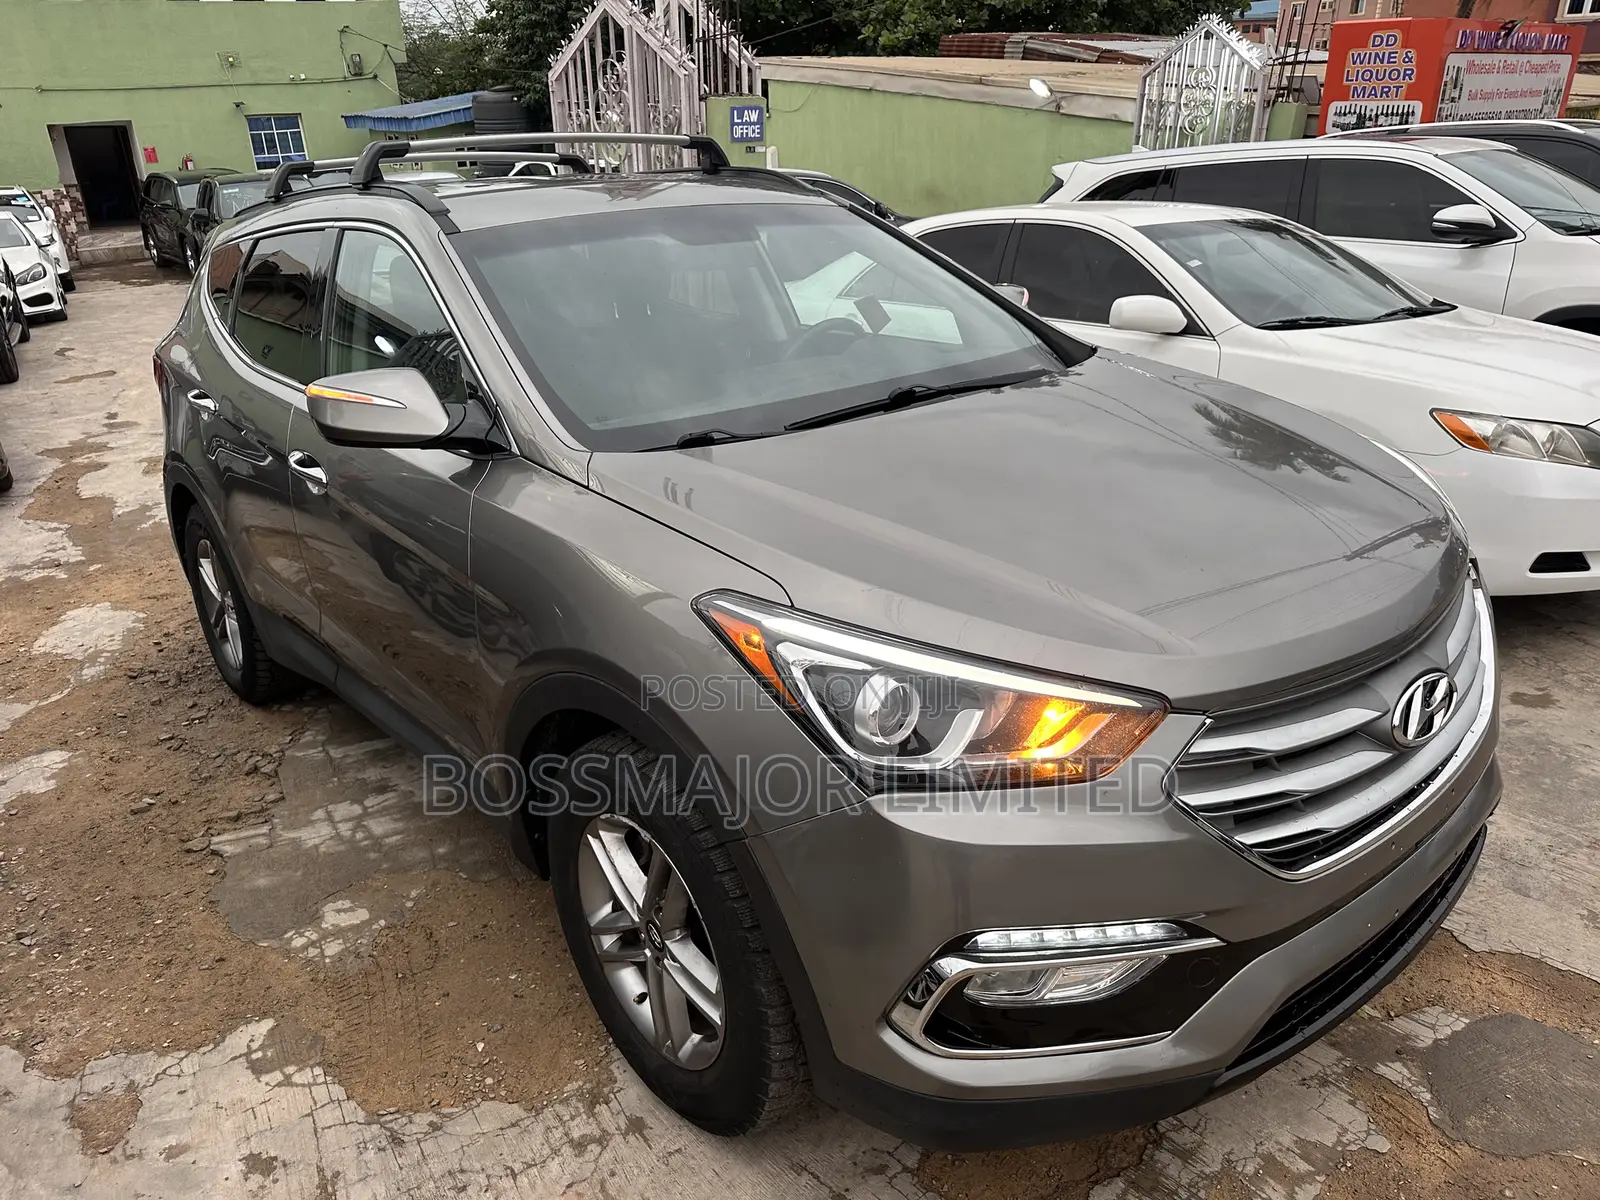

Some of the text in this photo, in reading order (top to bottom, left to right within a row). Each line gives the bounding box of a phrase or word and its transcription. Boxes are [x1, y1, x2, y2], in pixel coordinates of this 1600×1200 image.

[1371, 32, 1399, 48] DD
[1543, 34, 1571, 51] MART
[1350, 49, 1415, 66] WINE &
[1344, 67, 1416, 84] LIQUOR
[1466, 59, 1496, 75] Wholesale
[1501, 59, 1519, 75] Retail
[1524, 60, 1550, 77] Cheapest
[1548, 60, 1561, 74] Price
[1350, 84, 1404, 99] MART
[1467, 89, 1479, 101] Bulk
[1478, 88, 1496, 103] Supply
[1495, 88, 1504, 100] For
[1504, 87, 1520, 100] Events
[733, 109, 759, 123] LAW
[733, 125, 761, 138] OFFICE
